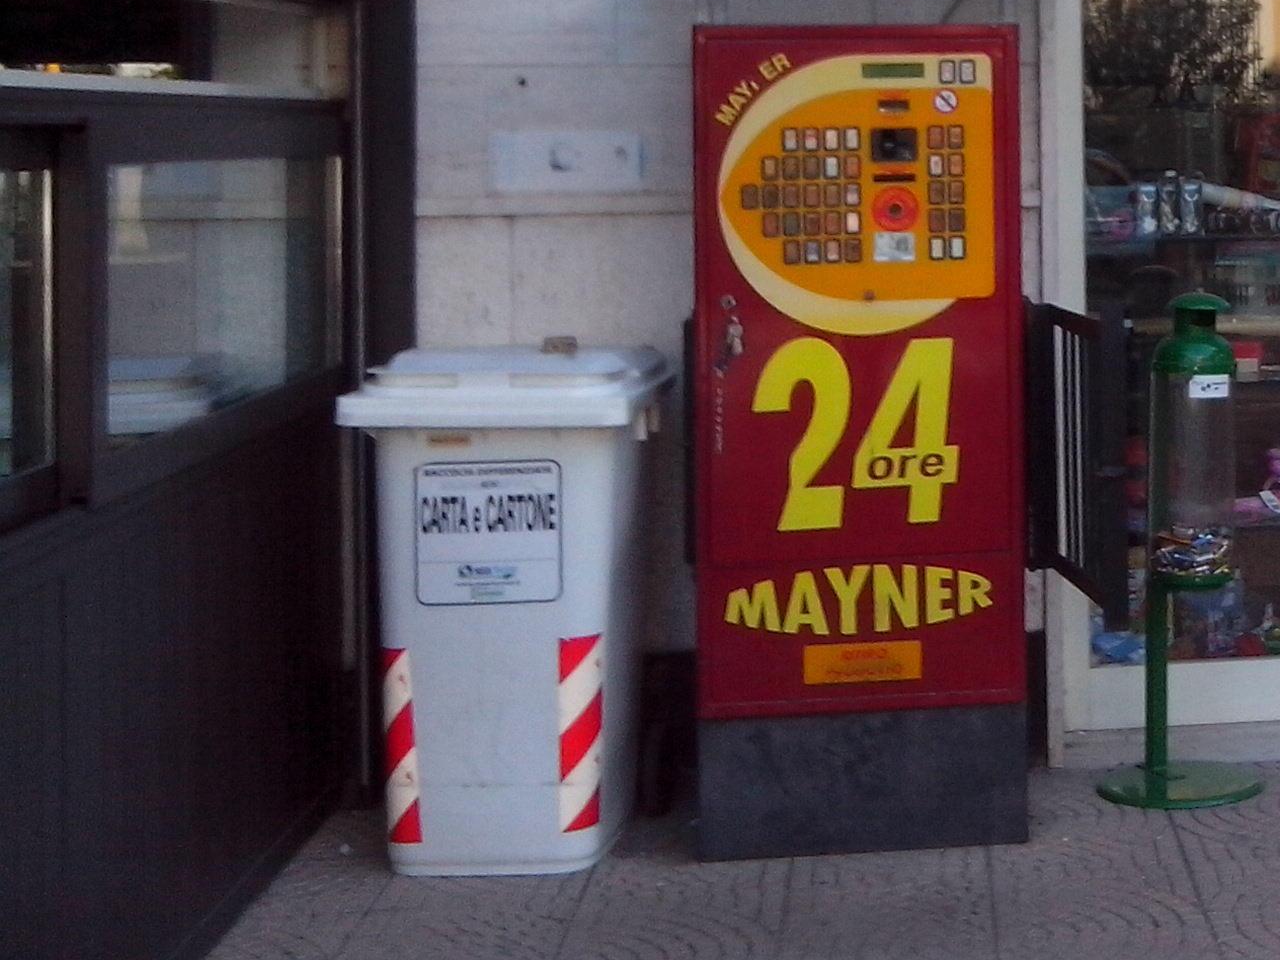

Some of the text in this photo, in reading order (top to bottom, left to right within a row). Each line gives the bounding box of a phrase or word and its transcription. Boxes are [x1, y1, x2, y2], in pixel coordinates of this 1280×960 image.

[751, 337, 961, 531] 24
[867, 451, 945, 482] ore
[422, 497, 469, 533] CARTA
[487, 493, 556, 531] CARTONE
[724, 564, 993, 635] MAYNER
